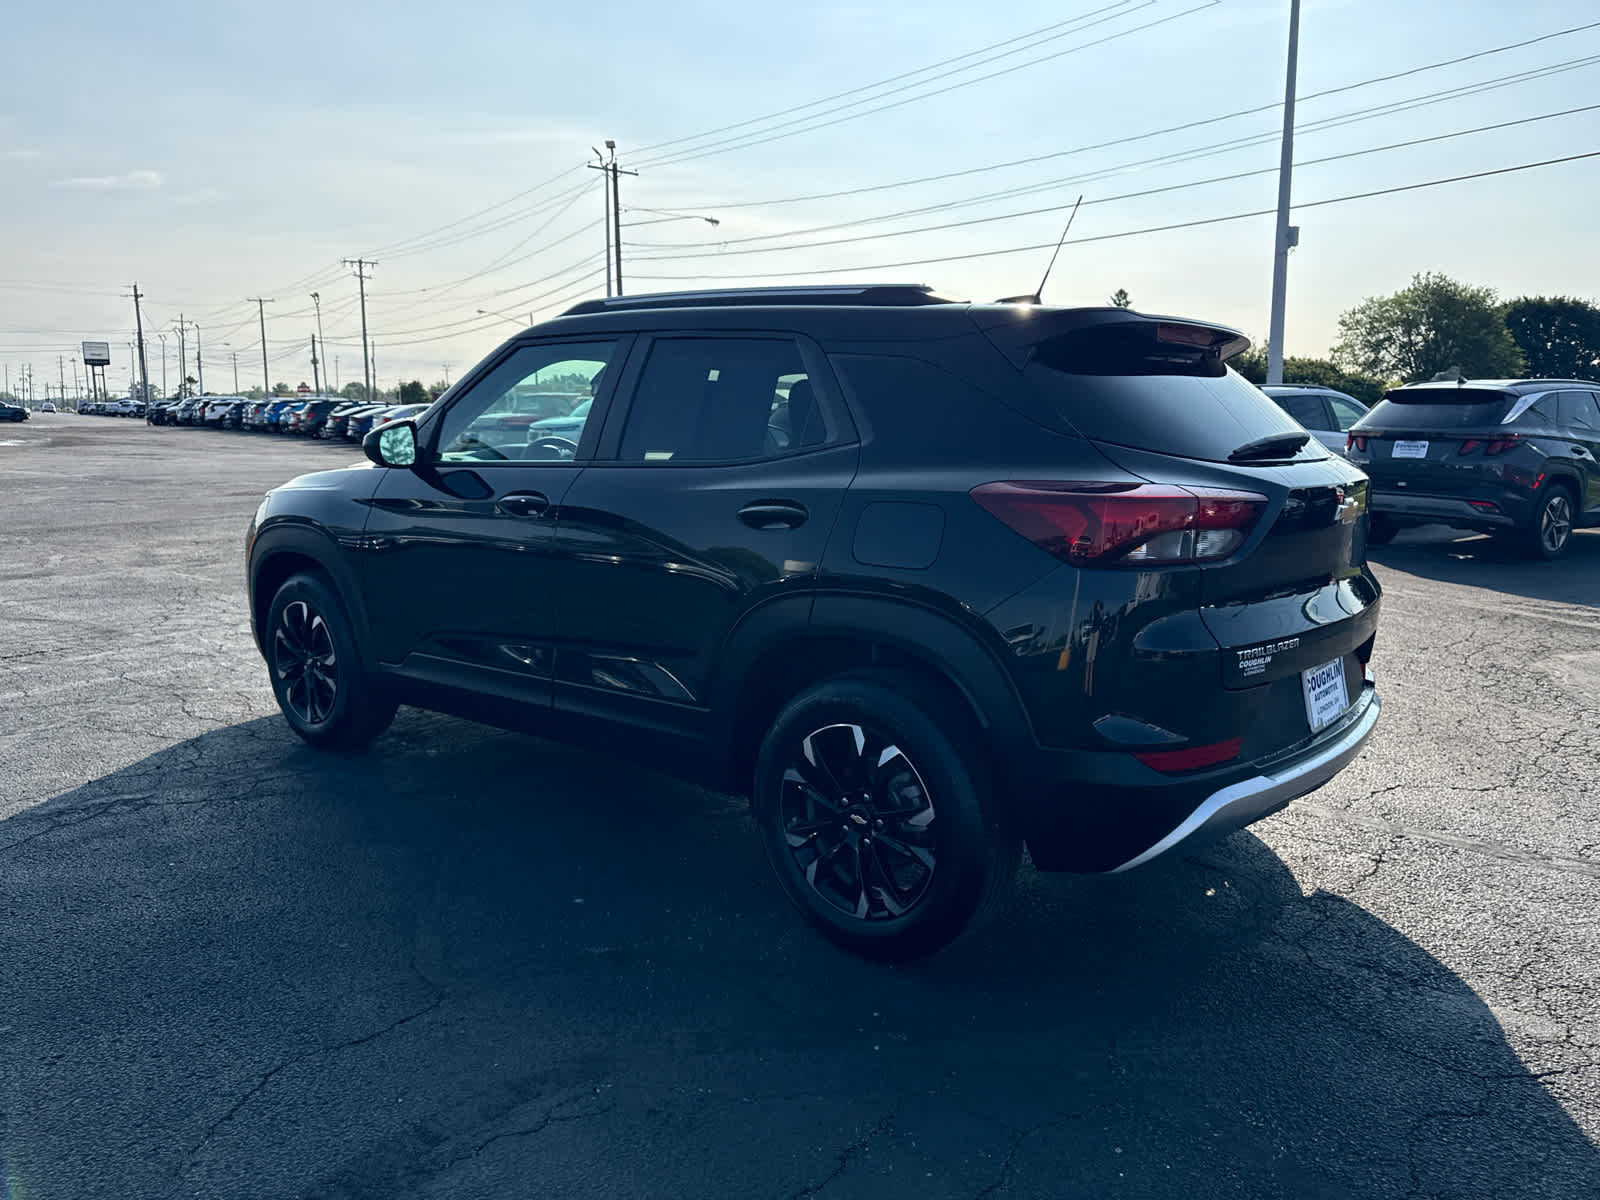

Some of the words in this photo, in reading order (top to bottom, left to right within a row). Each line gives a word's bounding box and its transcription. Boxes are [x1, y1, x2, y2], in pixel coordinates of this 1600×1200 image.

[1236, 637, 1300, 660] TRAILBLAZER
[1239, 655, 1272, 669] COUGHLIN
[1315, 682, 1338, 702] AUTOMOTIVE
